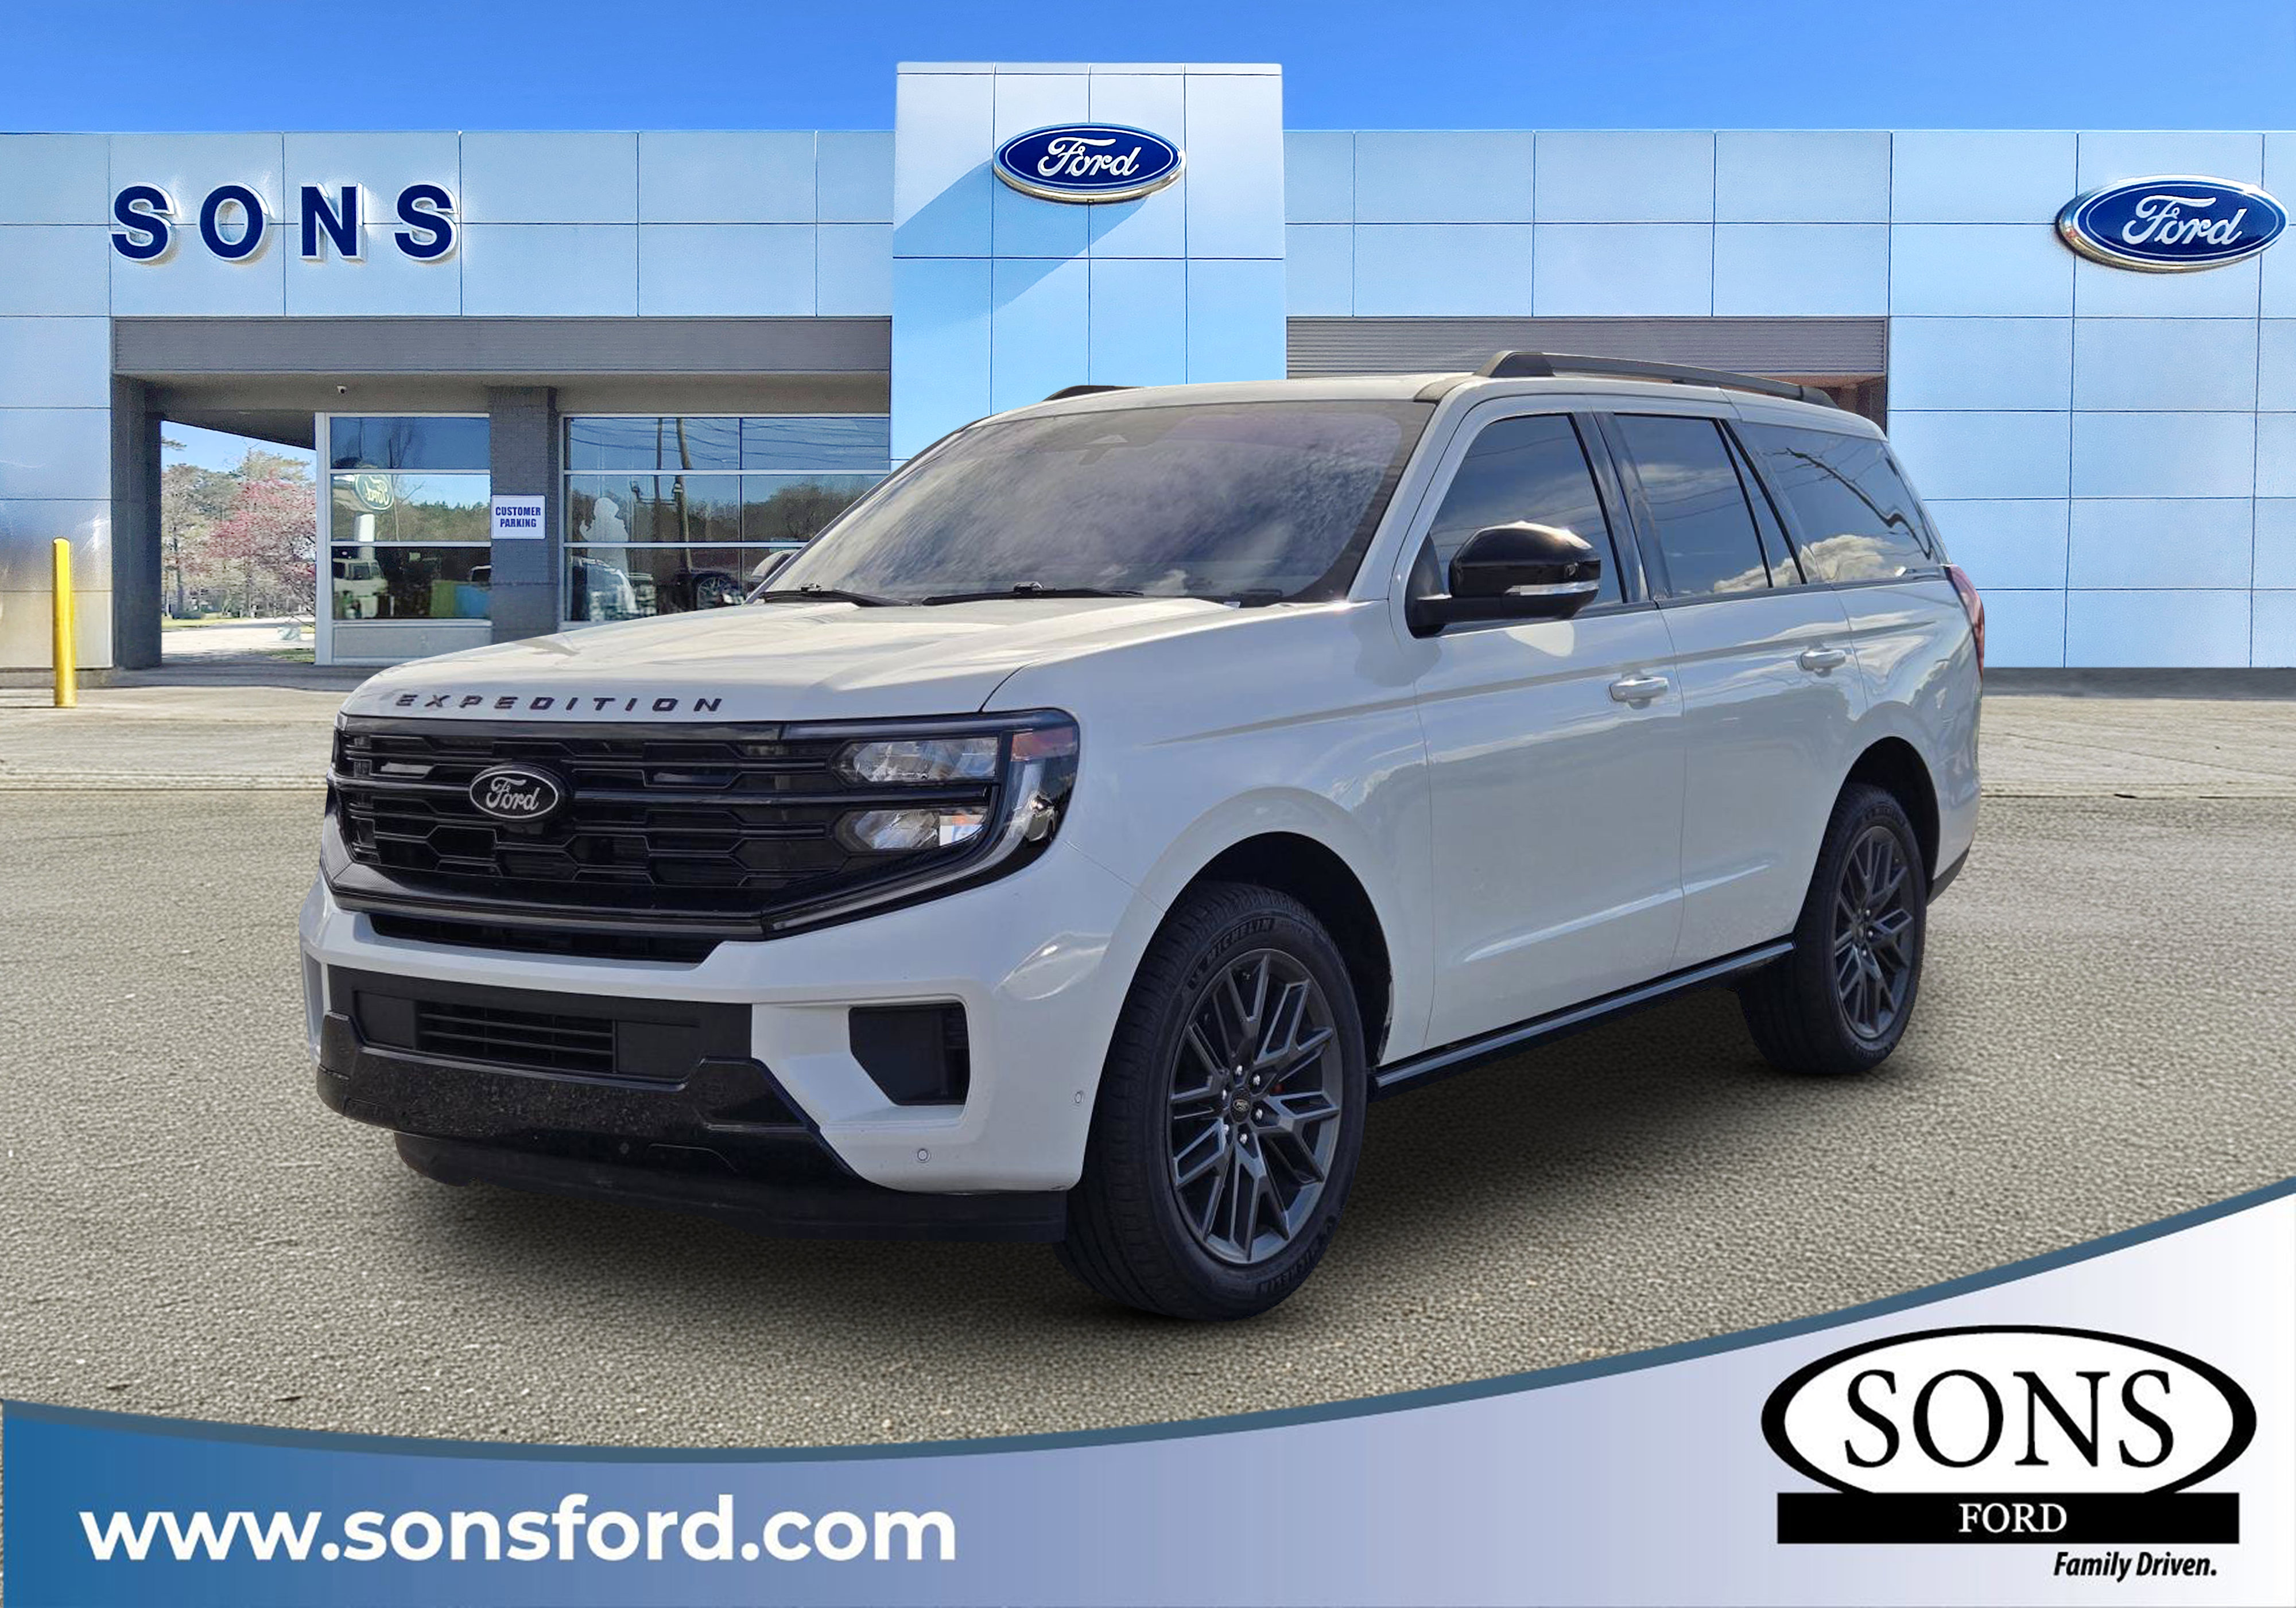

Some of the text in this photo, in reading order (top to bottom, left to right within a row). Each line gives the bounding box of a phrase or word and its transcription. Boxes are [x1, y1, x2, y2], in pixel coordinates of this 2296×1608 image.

[1037, 137, 1142, 177] Ford
[111, 183, 457, 260] SONS
[2122, 195, 2247, 245] Ford
[495, 506, 541, 516] CUSTOMER
[500, 518, 537, 527] PARKING
[395, 694, 723, 712] EXPEDITION
[486, 776, 541, 811] Ford
